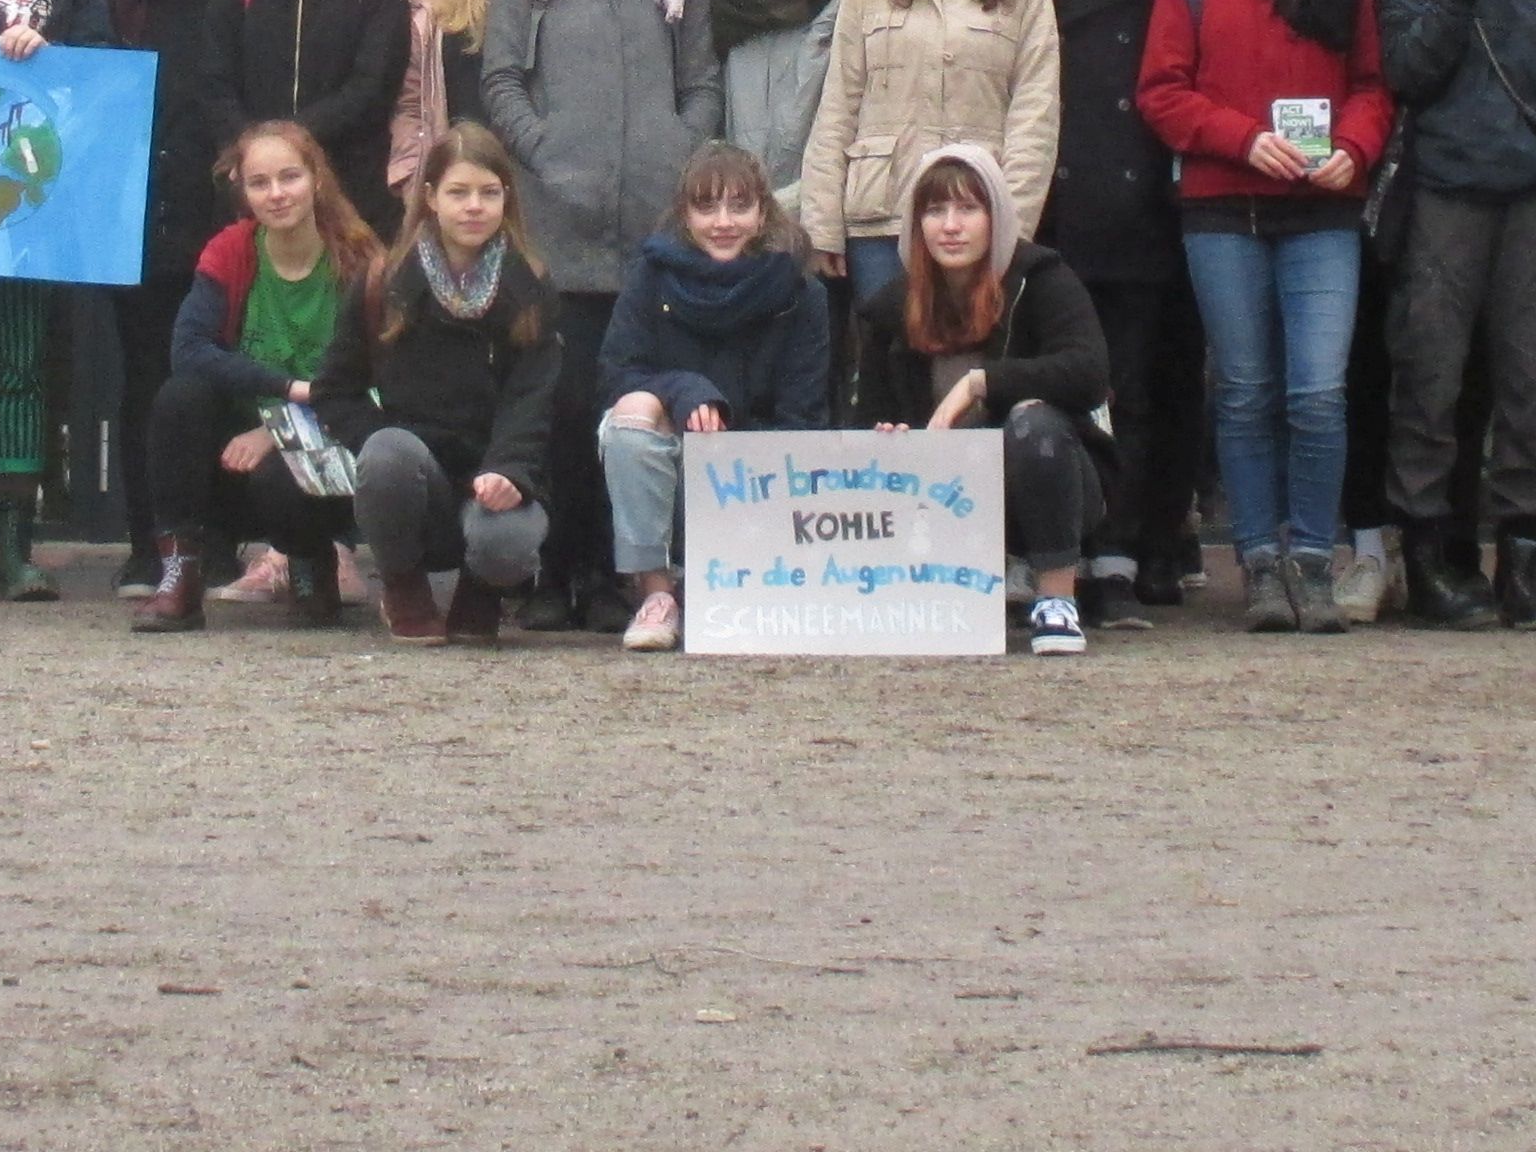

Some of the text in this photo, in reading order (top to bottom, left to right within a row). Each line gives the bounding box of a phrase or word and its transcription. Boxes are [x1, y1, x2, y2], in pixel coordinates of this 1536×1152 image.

[706, 453, 975, 519] Wir brauchen die
[792, 509, 895, 545] KOHLE
[762, 555, 806, 587] die
[821, 553, 905, 594] Augen
